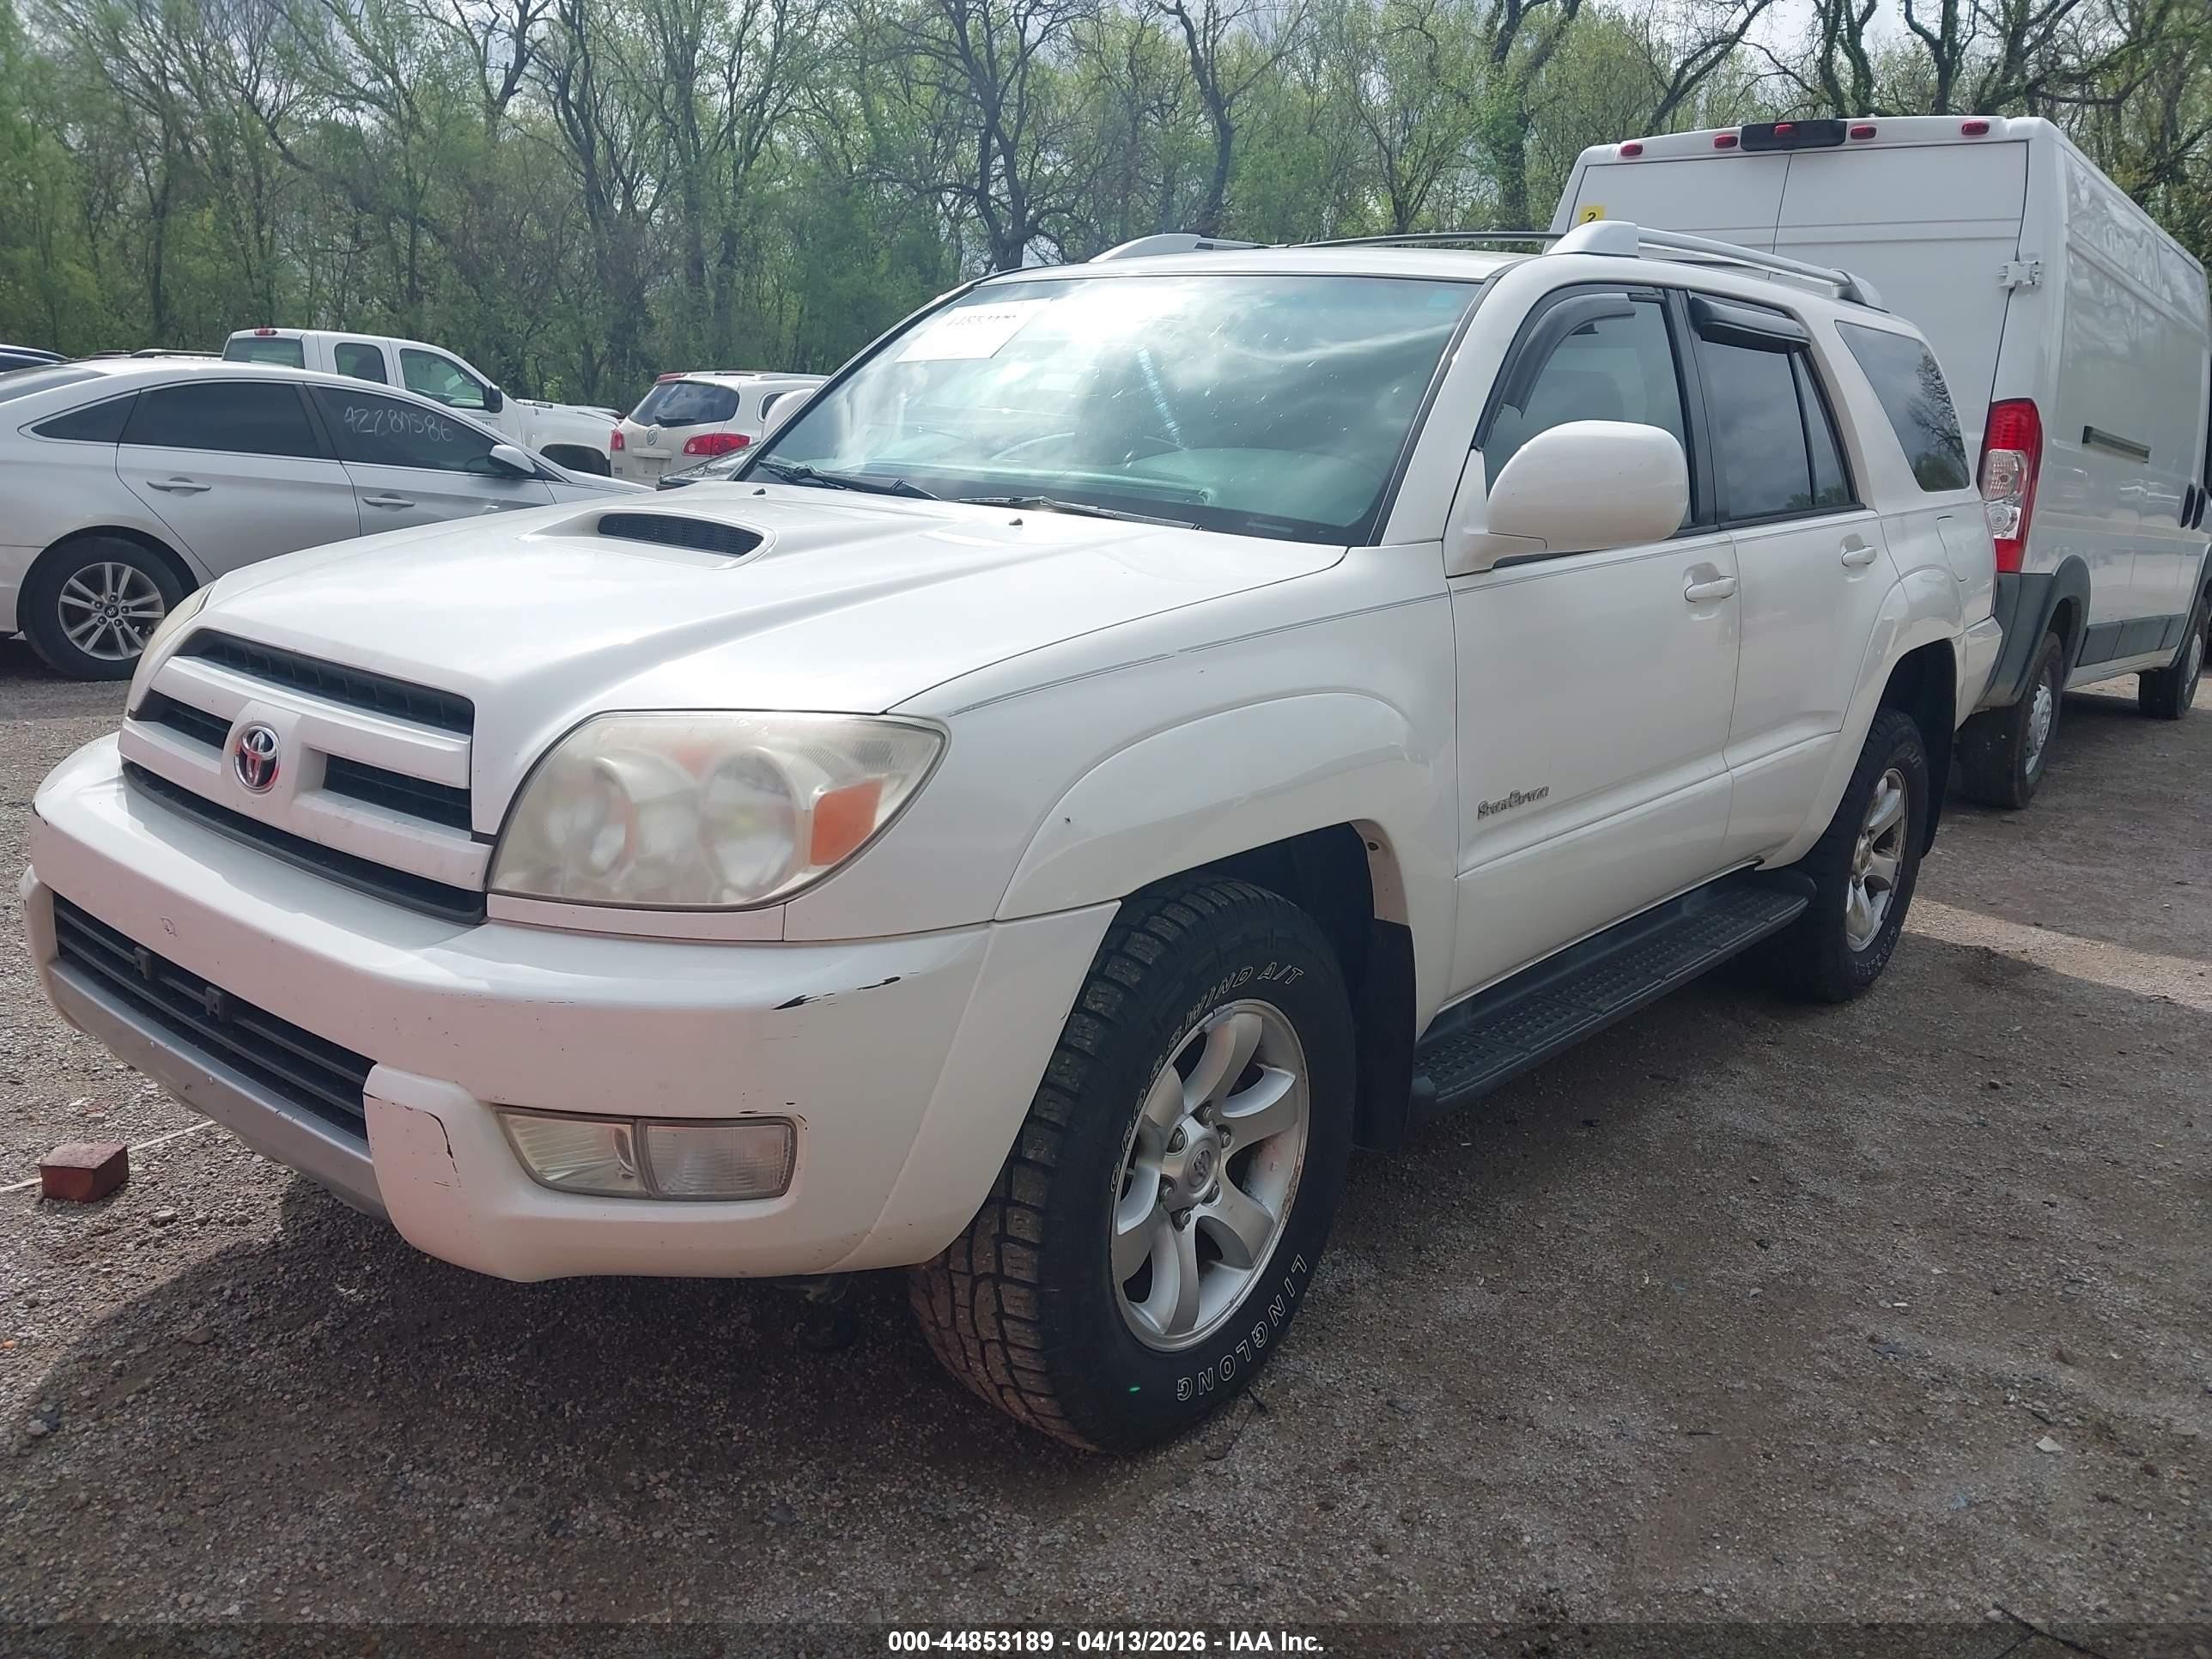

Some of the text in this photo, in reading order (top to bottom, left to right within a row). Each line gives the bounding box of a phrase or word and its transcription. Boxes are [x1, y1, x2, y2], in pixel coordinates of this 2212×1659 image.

[1586, 211, 1597, 223] 2
[1256, 961, 1305, 986] A/T
[1176, 1253, 1308, 1402] LINGLONG
